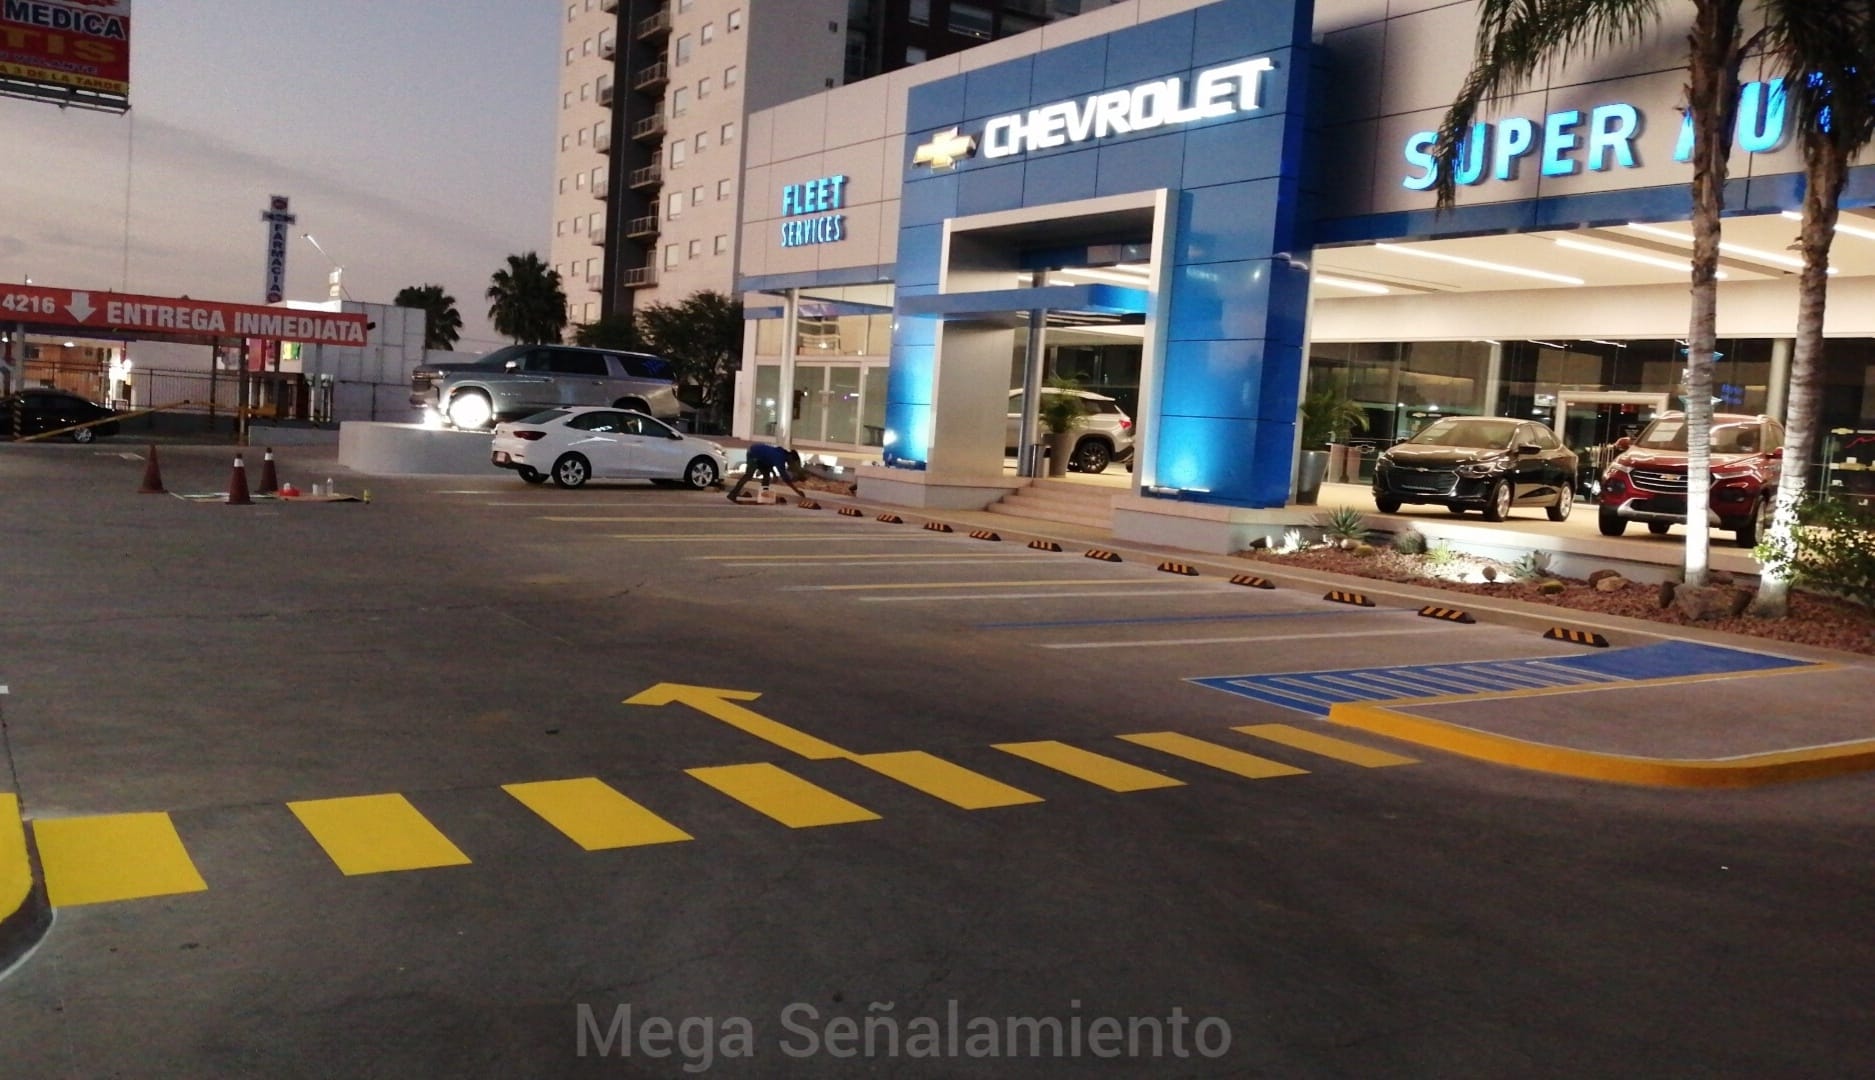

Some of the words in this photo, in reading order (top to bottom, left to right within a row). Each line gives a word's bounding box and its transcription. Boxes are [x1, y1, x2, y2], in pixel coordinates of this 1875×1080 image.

[4, 0, 126, 40] MEDICA
[75, 76, 122, 91] TARDE
[983, 57, 1275, 159] CHEVROLET
[1402, 103, 1639, 192] SUPER
[782, 174, 846, 216] FLEET
[780, 214, 844, 248] SERVICES
[270, 224, 284, 292] FARMACIA
[107, 301, 226, 333] ENTREGA
[234, 311, 366, 343] INMEDIATA
